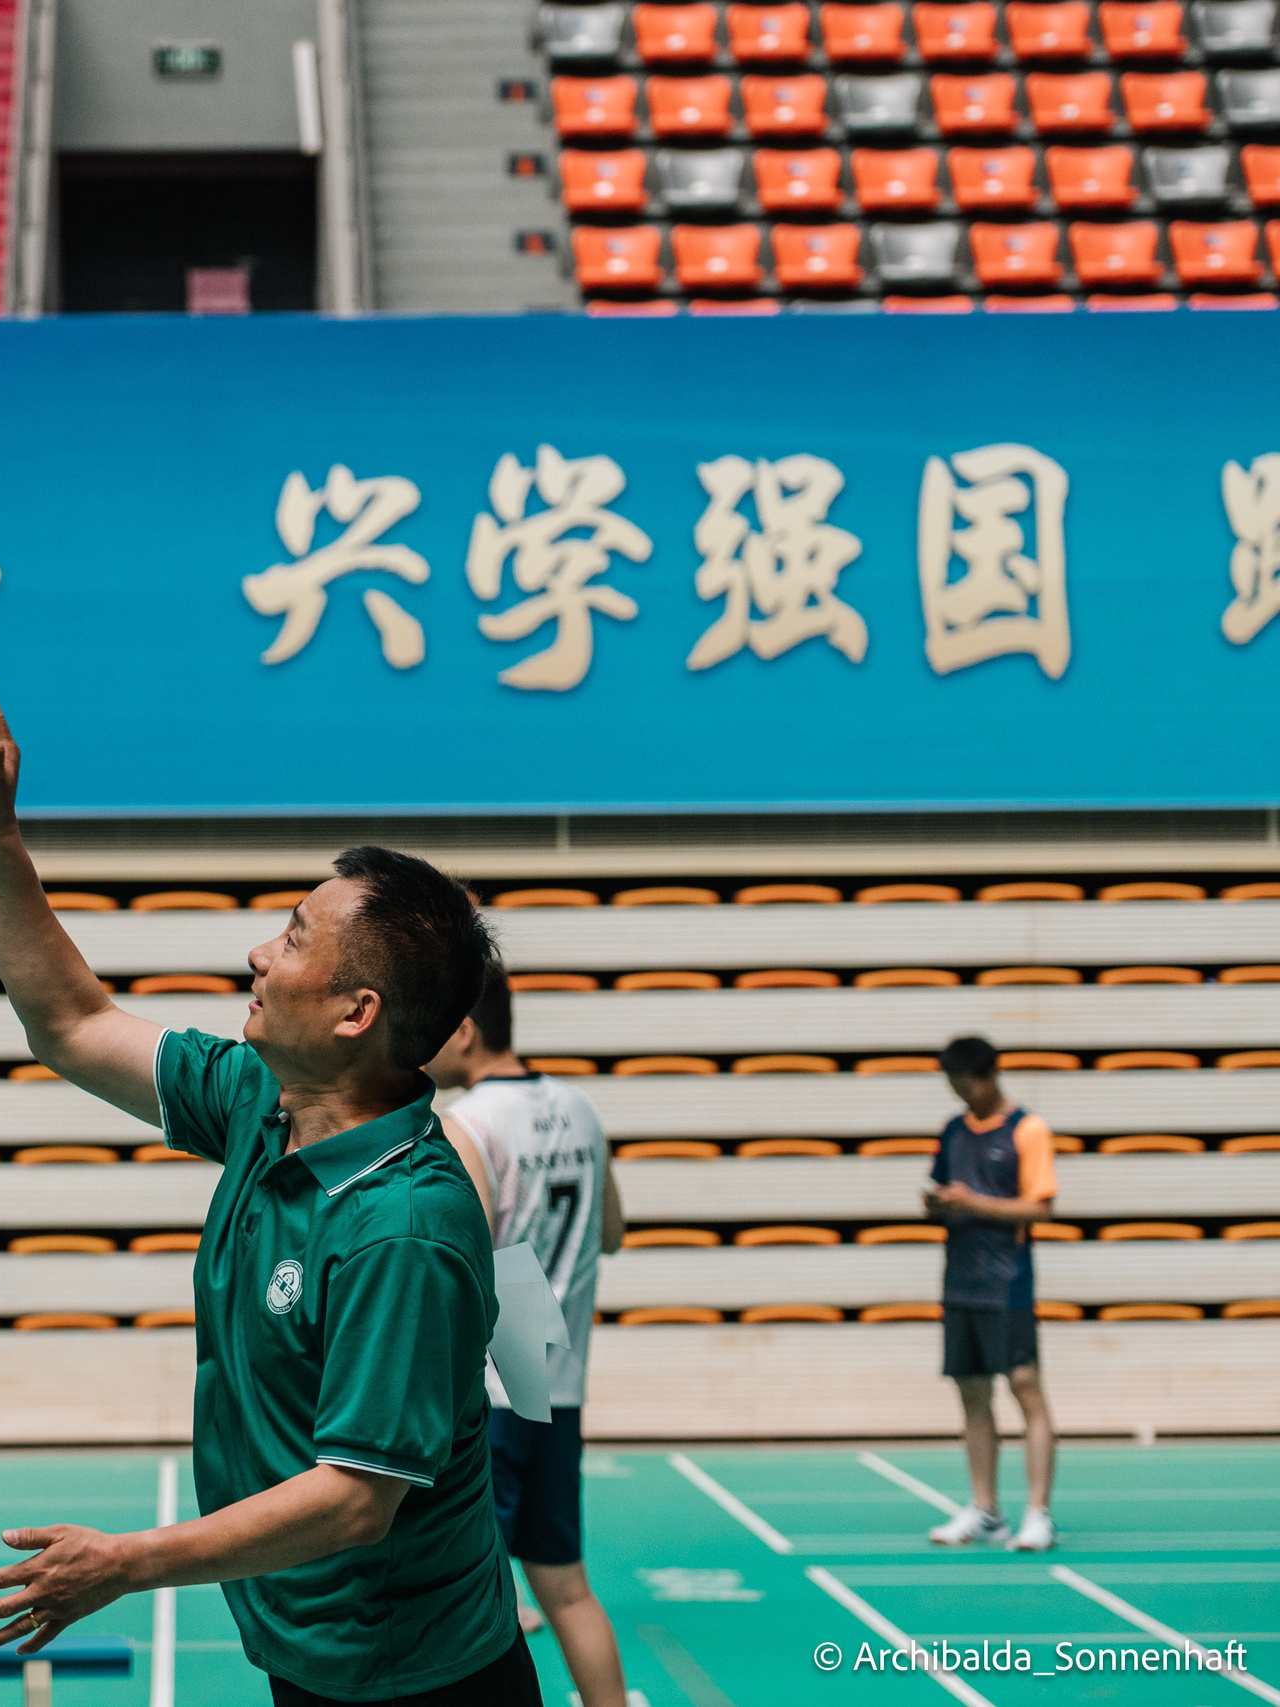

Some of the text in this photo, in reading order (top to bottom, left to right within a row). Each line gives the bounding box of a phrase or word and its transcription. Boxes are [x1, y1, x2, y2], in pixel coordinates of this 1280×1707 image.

[242, 443, 1072, 691] 兴学强国
[548, 1181, 580, 1280] 7
